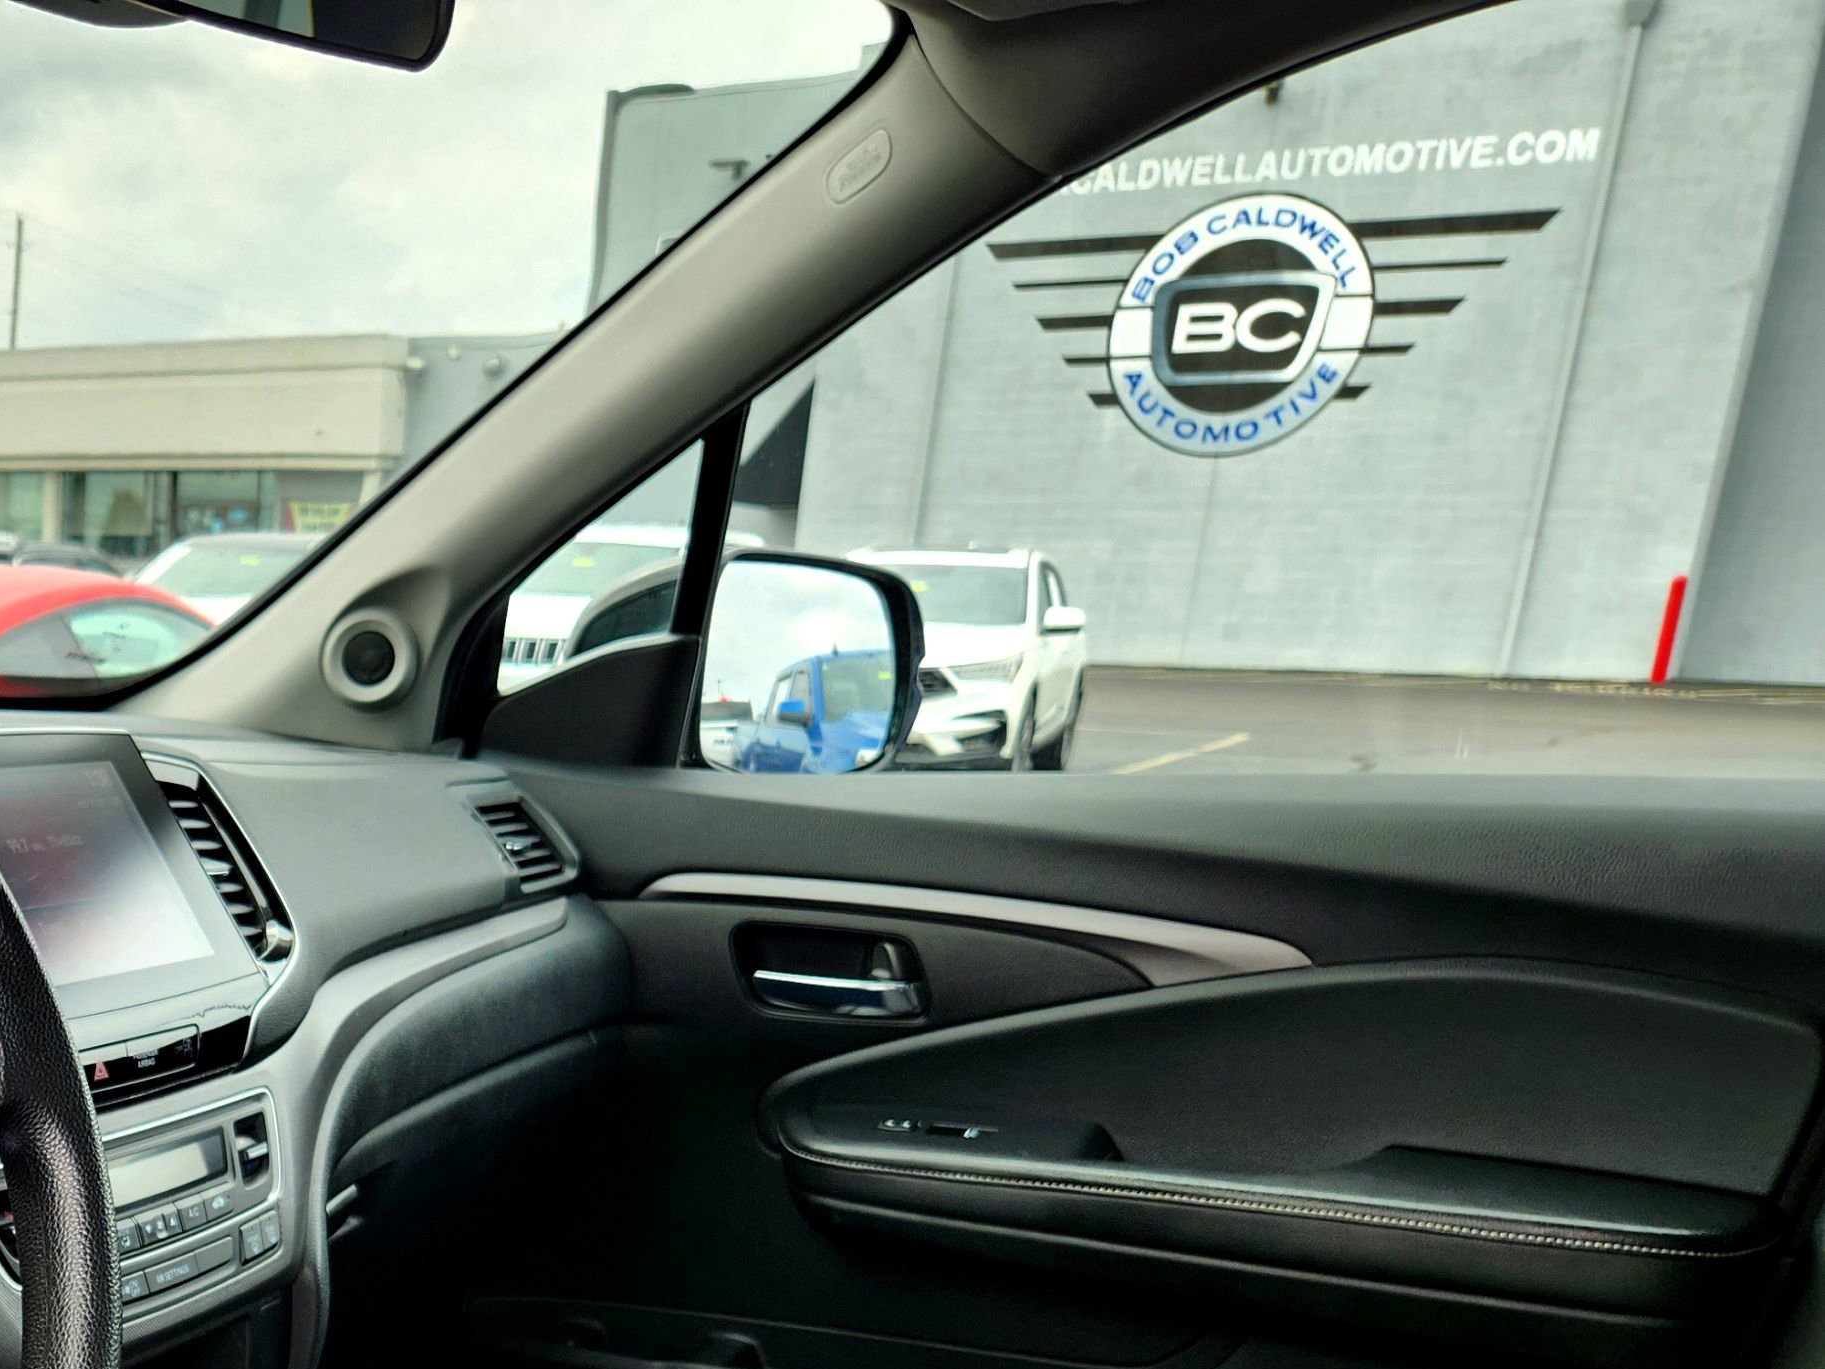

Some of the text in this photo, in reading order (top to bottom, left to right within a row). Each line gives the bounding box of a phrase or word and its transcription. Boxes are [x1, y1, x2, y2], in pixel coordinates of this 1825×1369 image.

[1058, 127, 1601, 196] CALDWELLAUTOMOTIVE.COM
[1132, 206, 1356, 303] BOB CALDWELL
[1171, 298, 1306, 354] BC
[1124, 361, 1339, 444] AUTOMOTIVE
